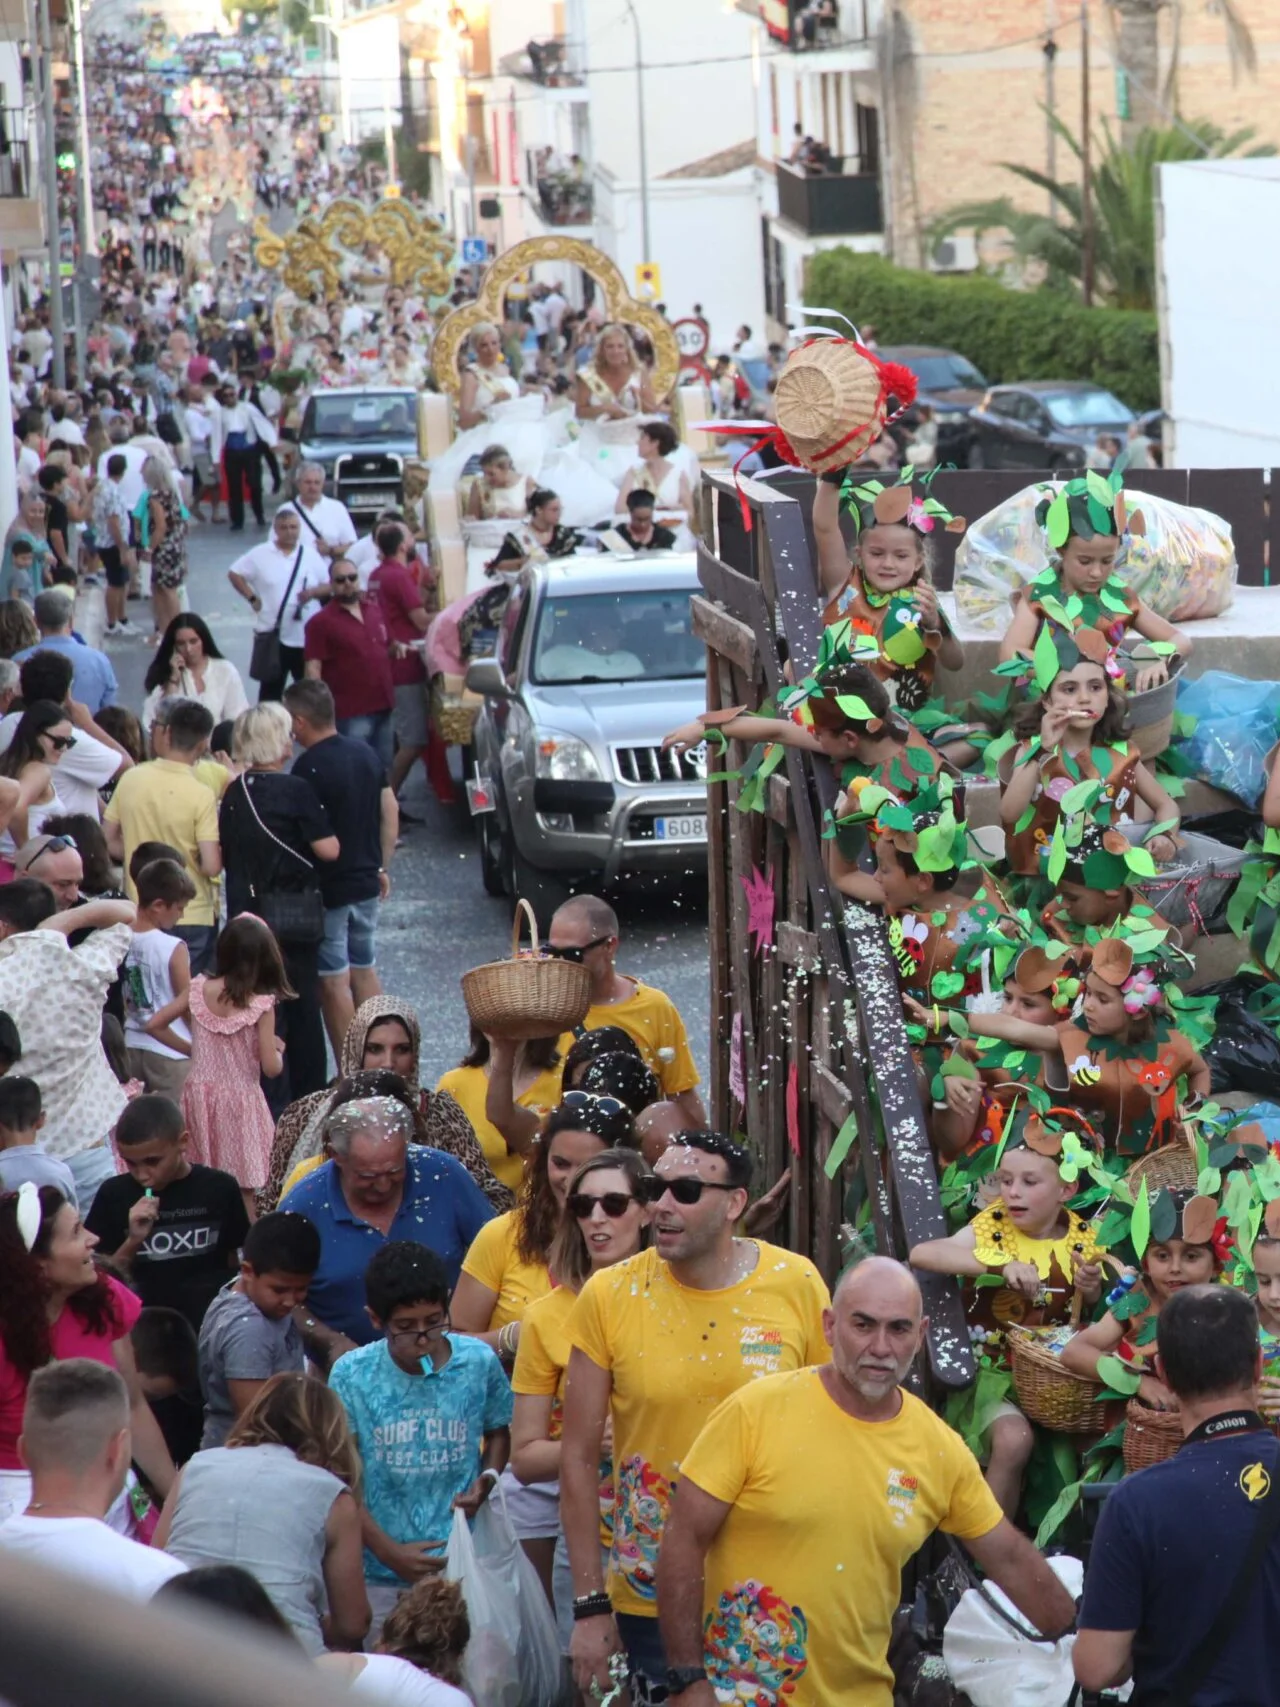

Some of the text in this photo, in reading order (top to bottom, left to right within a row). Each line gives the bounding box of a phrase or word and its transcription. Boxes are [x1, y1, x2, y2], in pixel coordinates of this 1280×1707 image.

[669, 819, 704, 837] 608
[374, 1418, 467, 1446] SURF CLUB
[1205, 1416, 1248, 1434] Canon
[420, 1445, 466, 1464] COAST
